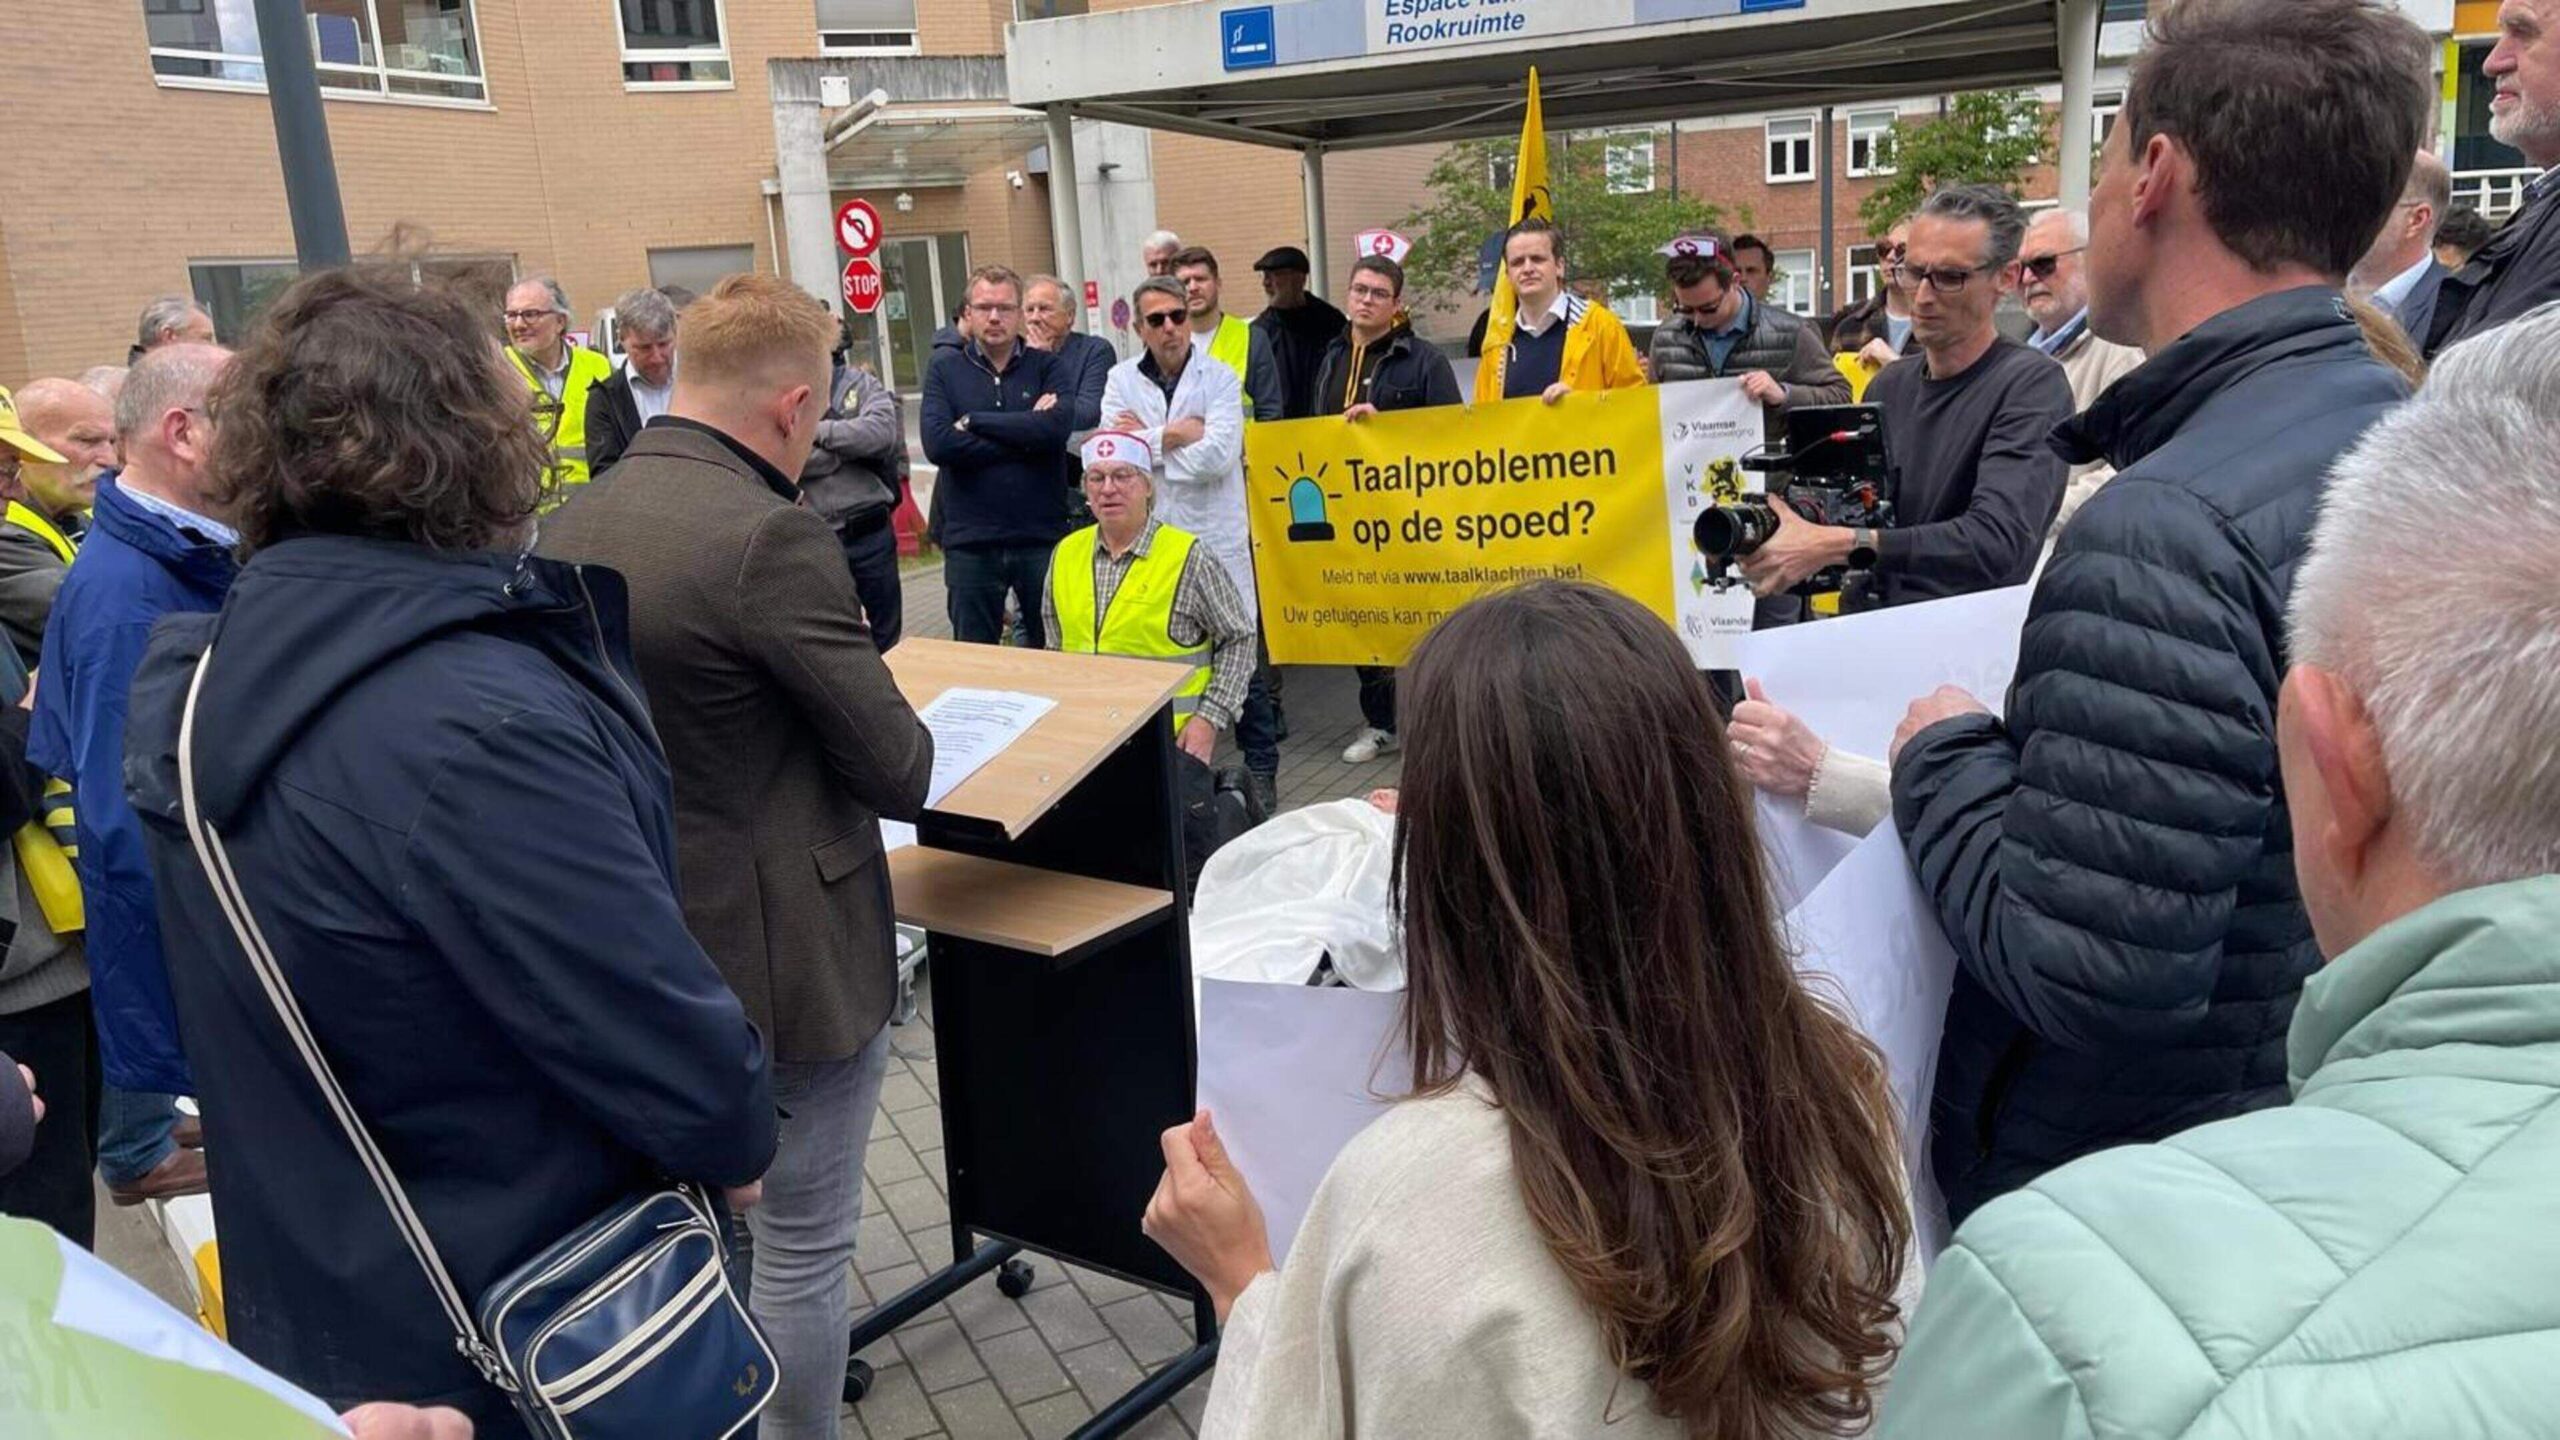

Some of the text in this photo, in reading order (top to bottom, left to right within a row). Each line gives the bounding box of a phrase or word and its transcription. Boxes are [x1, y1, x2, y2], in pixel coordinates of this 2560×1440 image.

[1387, 12, 1526, 44] Rookruimte
[845, 275, 878, 295] STOP
[1345, 448, 1616, 498] Taalproblemen
[1353, 500, 1595, 552] op de spoed?
[1322, 569, 1353, 585] Meld
[1358, 569, 1378, 585] het
[1383, 567, 1400, 584] via
[1283, 606, 1307, 624] Uw
[1313, 605, 1386, 627] getuigenis
[1394, 604, 1422, 625] kan
